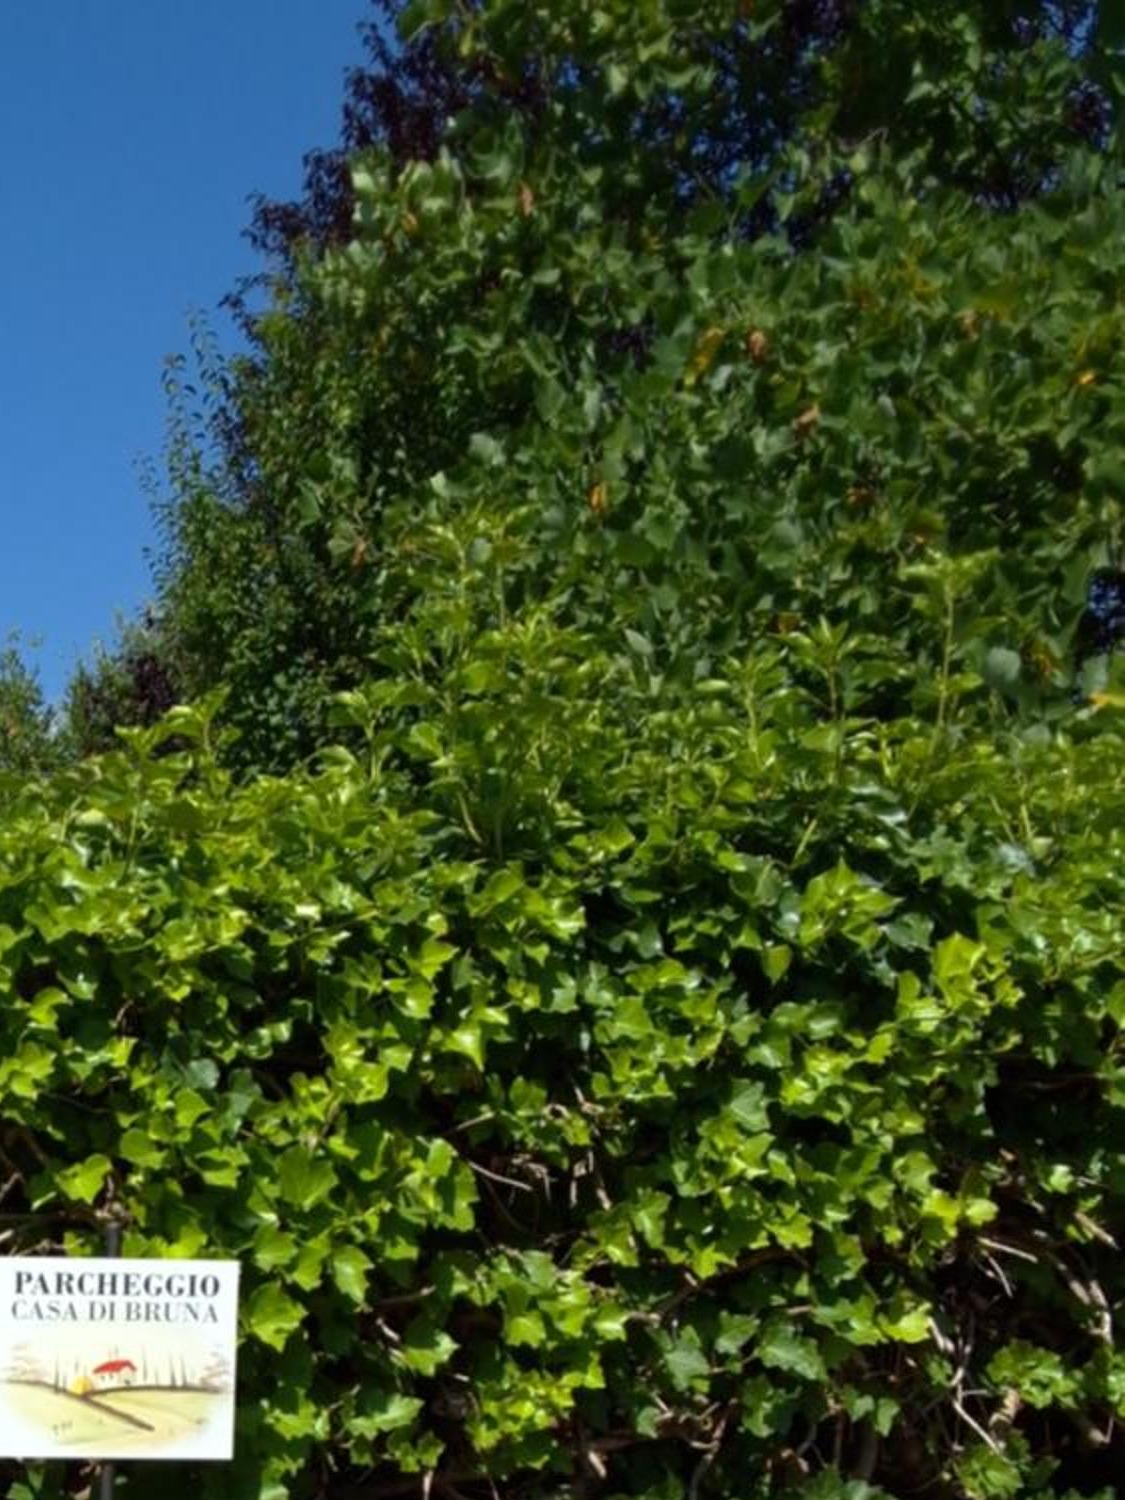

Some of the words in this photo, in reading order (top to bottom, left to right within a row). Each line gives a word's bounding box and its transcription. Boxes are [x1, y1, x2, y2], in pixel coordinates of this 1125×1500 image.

[14, 1270, 220, 1298] PARCHEGGIO
[11, 1299, 78, 1322] CASA
[88, 1301, 115, 1322] DI
[125, 1301, 219, 1324] BRUNA
